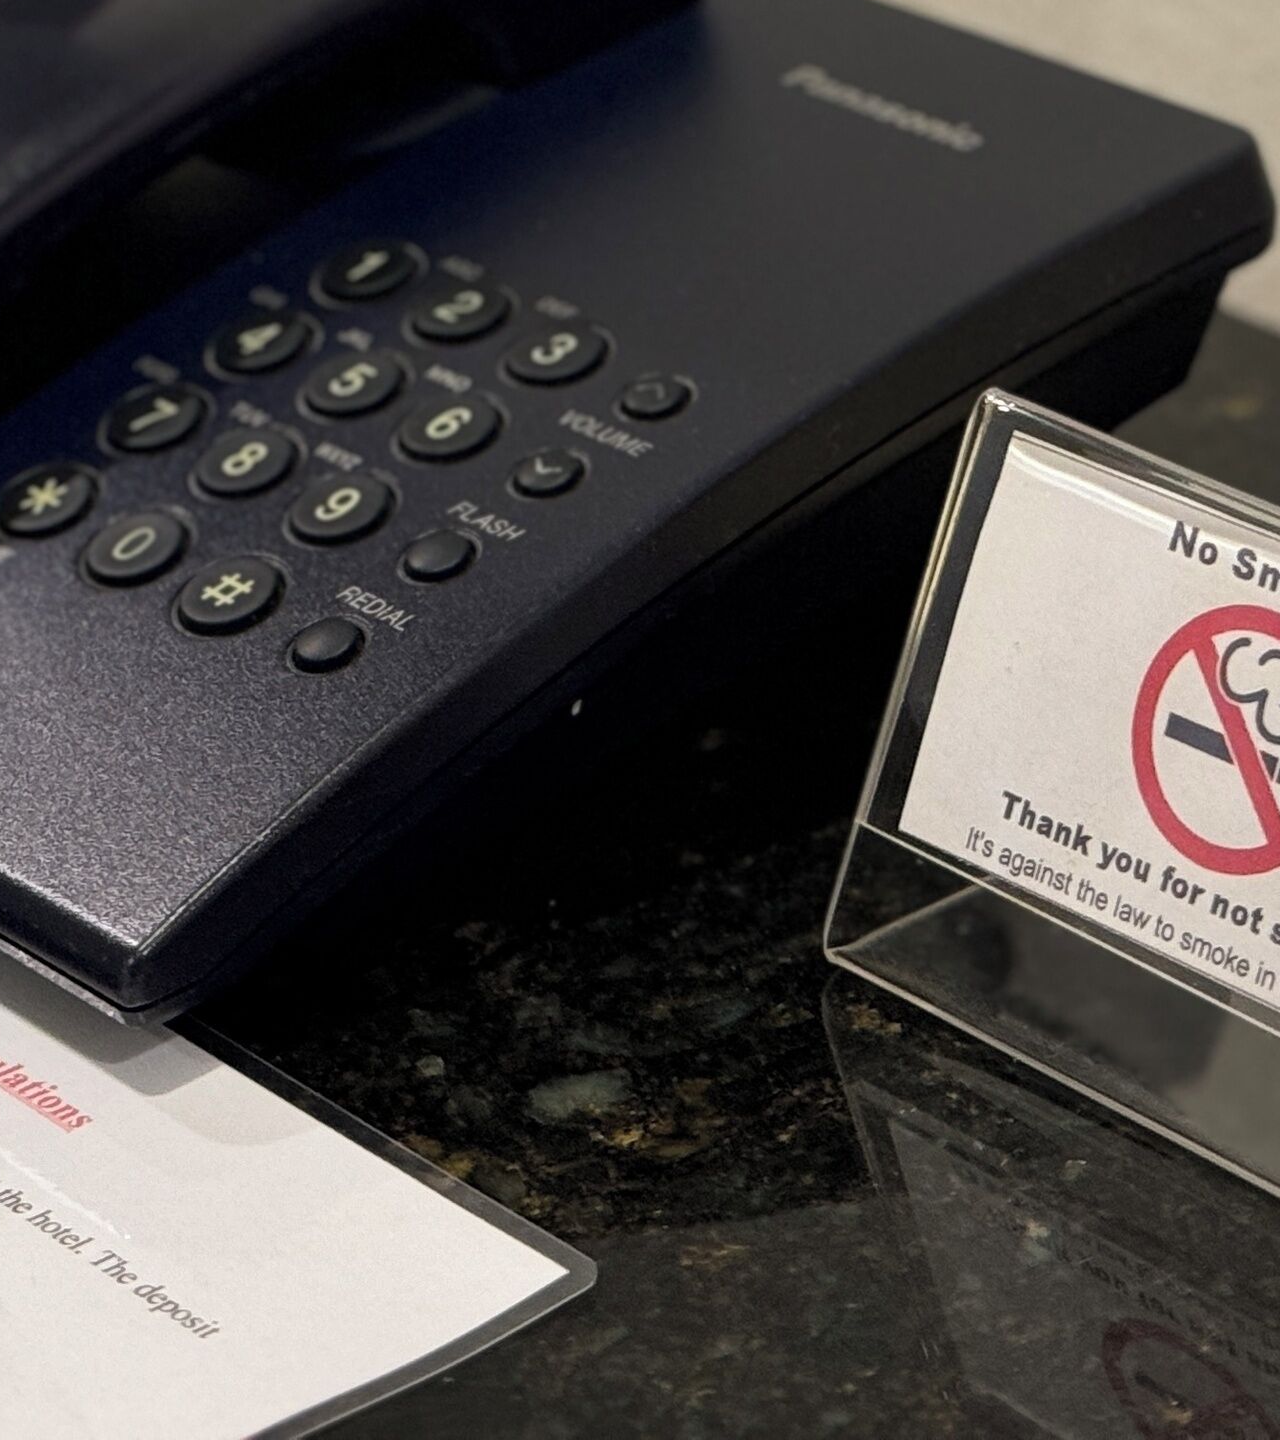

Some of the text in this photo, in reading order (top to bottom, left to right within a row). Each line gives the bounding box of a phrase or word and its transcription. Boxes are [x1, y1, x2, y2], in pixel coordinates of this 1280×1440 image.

[346, 250, 578, 366] 1 2 3
[237, 321, 473, 441] 4 5 6
[559, 411, 655, 458] VOLUME
[128, 396, 362, 521] 7 8 9
[111, 526, 157, 561] 0
[447, 500, 527, 542] FLASH
[1168, 519, 1219, 566] No
[335, 585, 418, 632] REDIAL
[964, 826, 996, 859] It's
[997, 846, 1075, 897] against
[1075, 877, 1109, 912] the
[1112, 893, 1153, 932] law
[1152, 913, 1176, 943] to
[1177, 931, 1251, 979] smoke
[1253, 960, 1277, 992] in
[1001, 789, 1094, 867] Thank
[1094, 840, 1152, 885] you
[1158, 864, 1207, 907] for
[1208, 893, 1265, 937] not
[24, 1208, 96, 1255] hotel.
[88, 1249, 139, 1285] The
[131, 1284, 221, 1340] deposit
